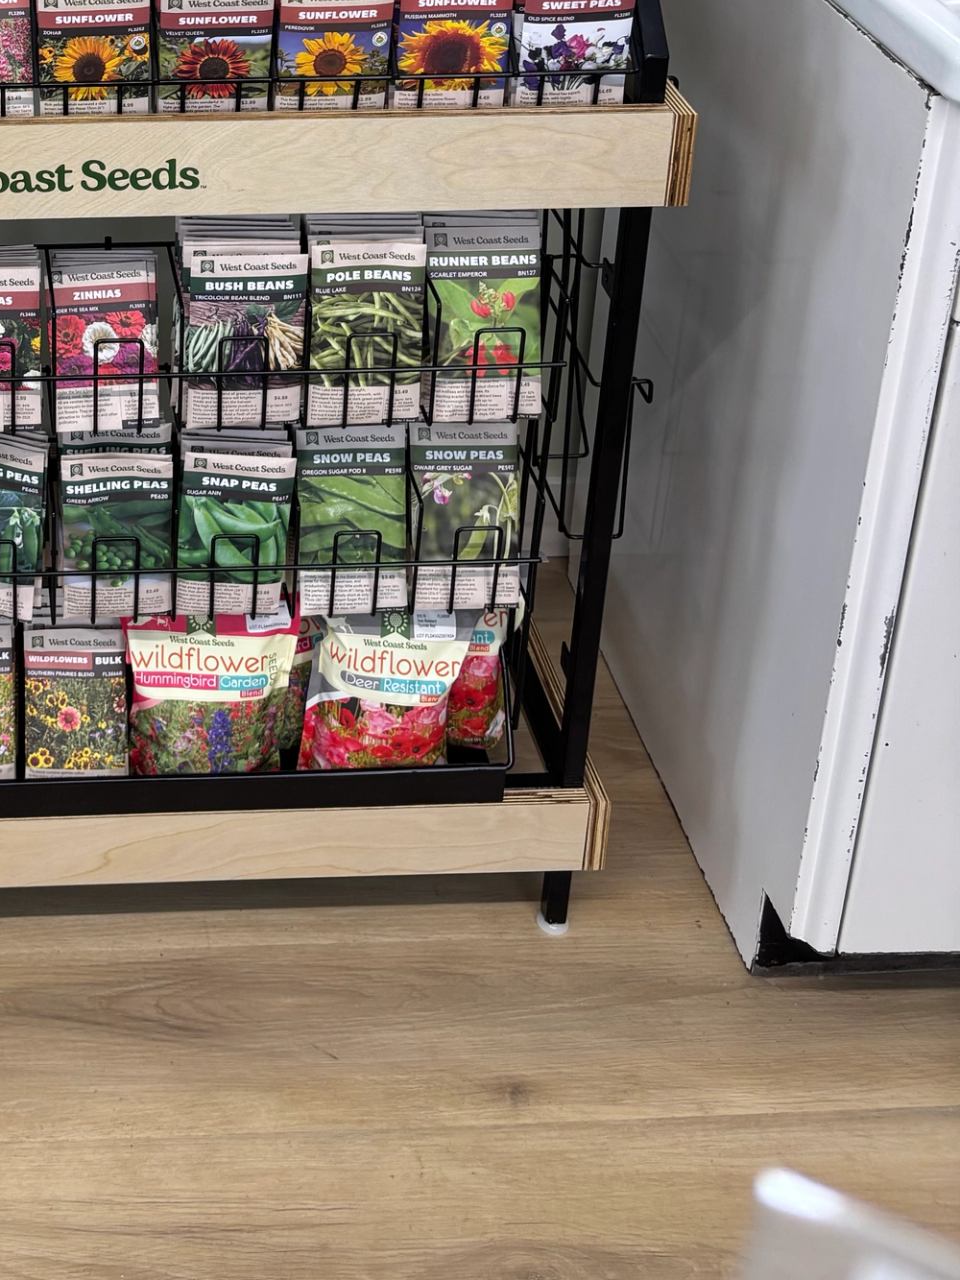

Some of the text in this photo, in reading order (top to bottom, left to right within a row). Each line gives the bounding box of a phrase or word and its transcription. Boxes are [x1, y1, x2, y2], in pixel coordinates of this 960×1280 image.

[542, 0, 587, 10] SWEET
[55, 13, 133, 24] SUNFLOWER
[299, 10, 378, 19] SUNFLOWER
[81, 158, 200, 191] Seeds
[430, 255, 537, 266] RUNNER BEANS
[243, 263, 269, 271] Coast
[271, 262, 297, 270] Seeds
[327, 270, 411, 283] POLE BEANS
[205, 280, 294, 291] BUSH BEANS
[73, 289, 121, 300] ZINNIAS
[313, 453, 391, 464] SNOW PEAS
[66, 480, 168, 494] SHELLING PEAS
[202, 476, 277, 492] SNAP PEAS
[169, 635, 235, 647] West Coast Seeds
[29, 656, 122, 665] WILDFLOWERS BULK
[131, 640, 268, 673] wildflower
[330, 639, 460, 681] wildflower
[134, 672, 268, 689] Hummingbird Garden
[347, 674, 443, 696] Deer Resistant
